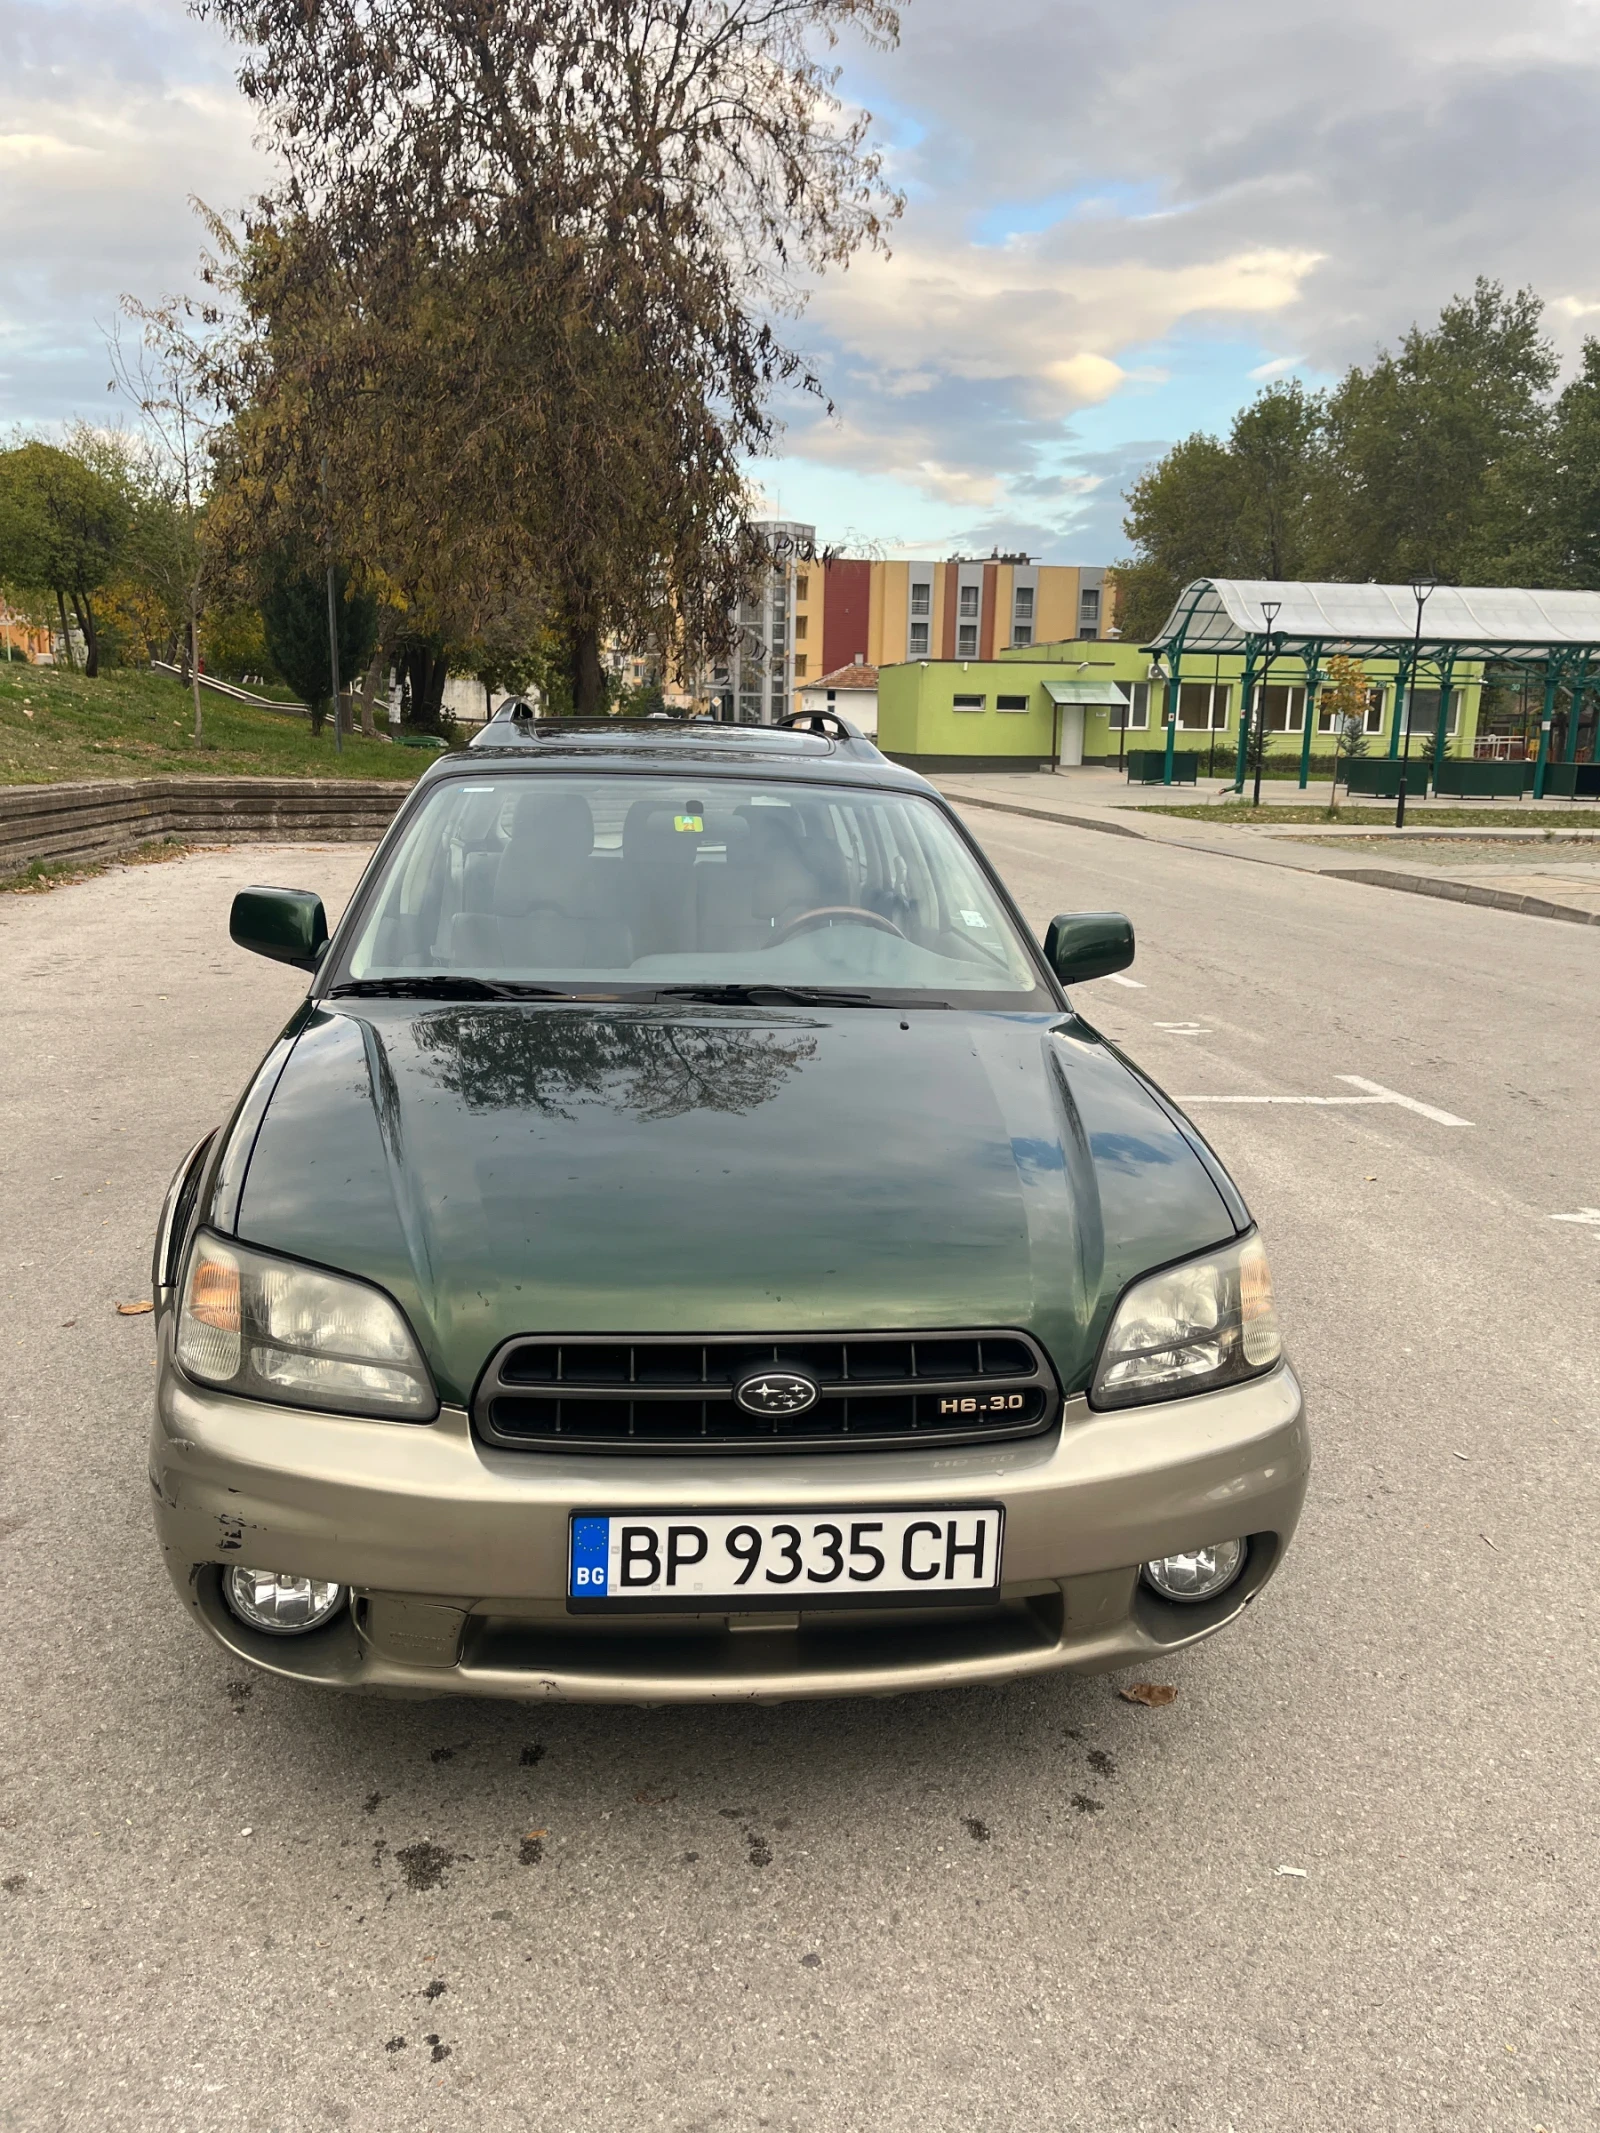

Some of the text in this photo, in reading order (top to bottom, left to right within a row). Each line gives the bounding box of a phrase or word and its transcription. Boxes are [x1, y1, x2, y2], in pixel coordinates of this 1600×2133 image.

[1511, 683, 1521, 691] 30
[620, 1519, 986, 1587] BP 9335 CH
[577, 1567, 605, 1585] BG
